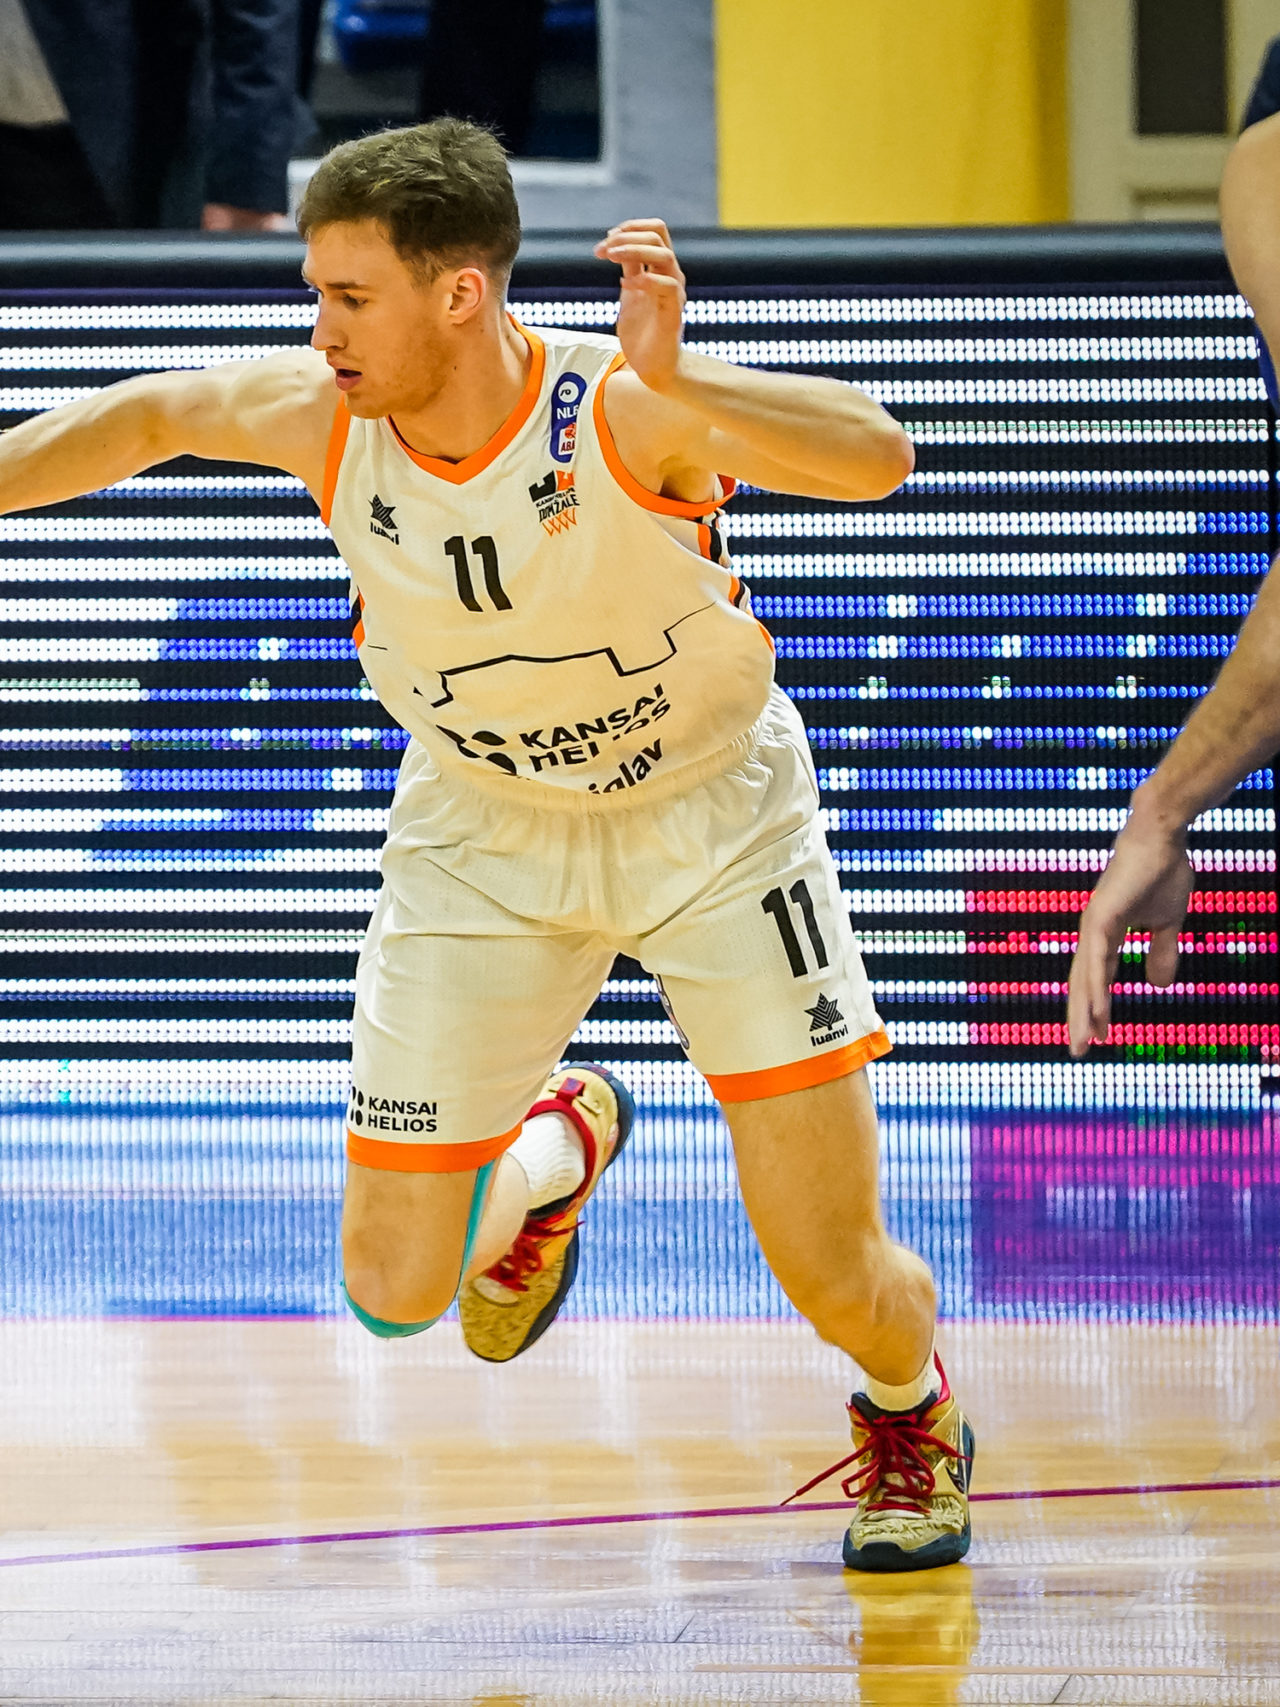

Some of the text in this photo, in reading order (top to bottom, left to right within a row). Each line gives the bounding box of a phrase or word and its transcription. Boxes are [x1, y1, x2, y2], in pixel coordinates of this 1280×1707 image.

[443, 535, 513, 613] 11
[518, 683, 664, 750] KANSAI
[760, 878, 829, 979] 11
[810, 1024, 849, 1048] luanvi
[367, 1113, 438, 1133] HELIOS
[368, 1095, 438, 1116] KANSAI
